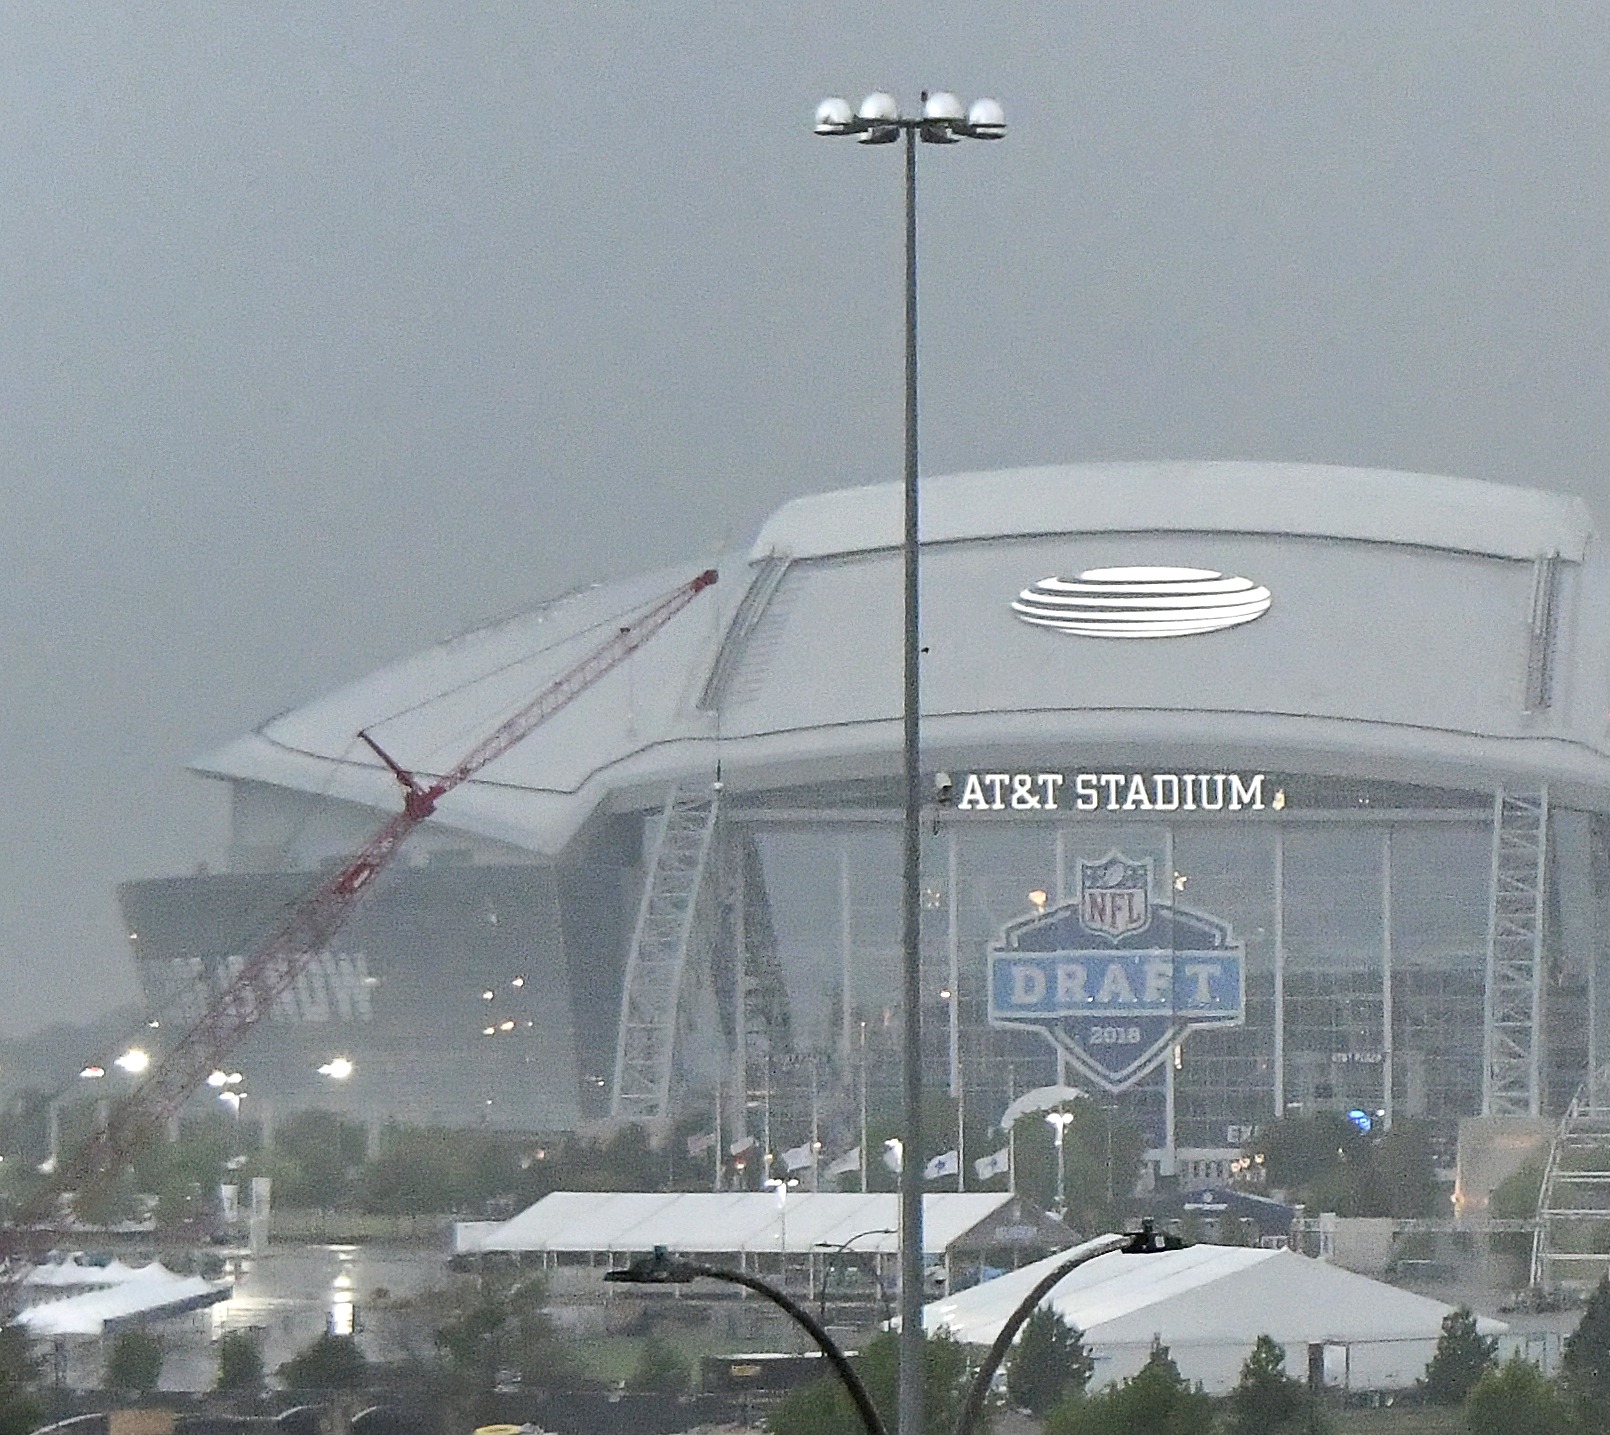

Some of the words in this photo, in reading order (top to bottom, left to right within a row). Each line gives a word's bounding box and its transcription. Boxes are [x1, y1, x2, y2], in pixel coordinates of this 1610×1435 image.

[958, 774, 1062, 810] AT&T
[1076, 774, 1265, 810] STADIUM
[1086, 892, 1141, 926] NFL
[1010, 961, 1222, 1004] DRAFT
[1090, 1026, 1140, 1044] 2018
